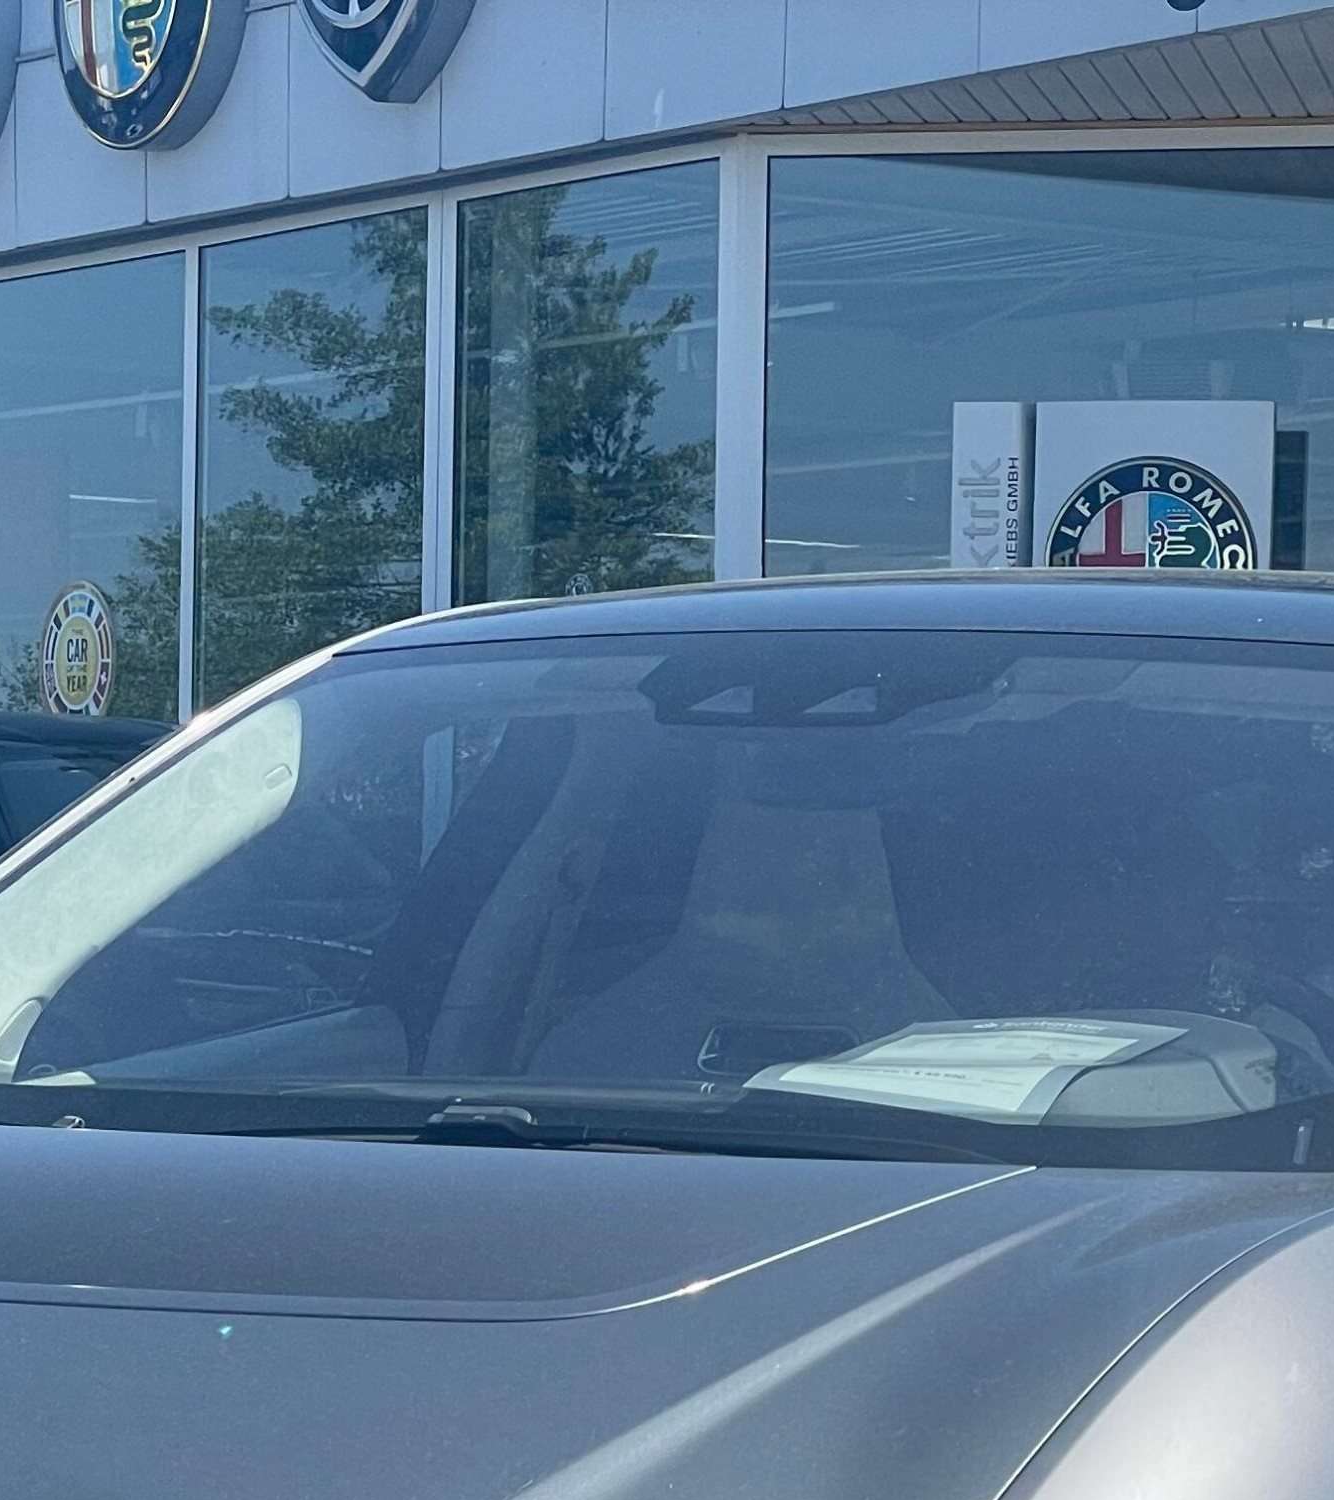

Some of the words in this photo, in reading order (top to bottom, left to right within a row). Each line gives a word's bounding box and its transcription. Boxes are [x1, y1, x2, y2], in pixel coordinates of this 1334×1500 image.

[1007, 457, 1019, 511] GMBH
[1006, 519, 1019, 568] IEBS
[1052, 479, 1121, 568] ALFA
[67, 638, 88, 663] CAR
[67, 675, 88, 693] YEAR
